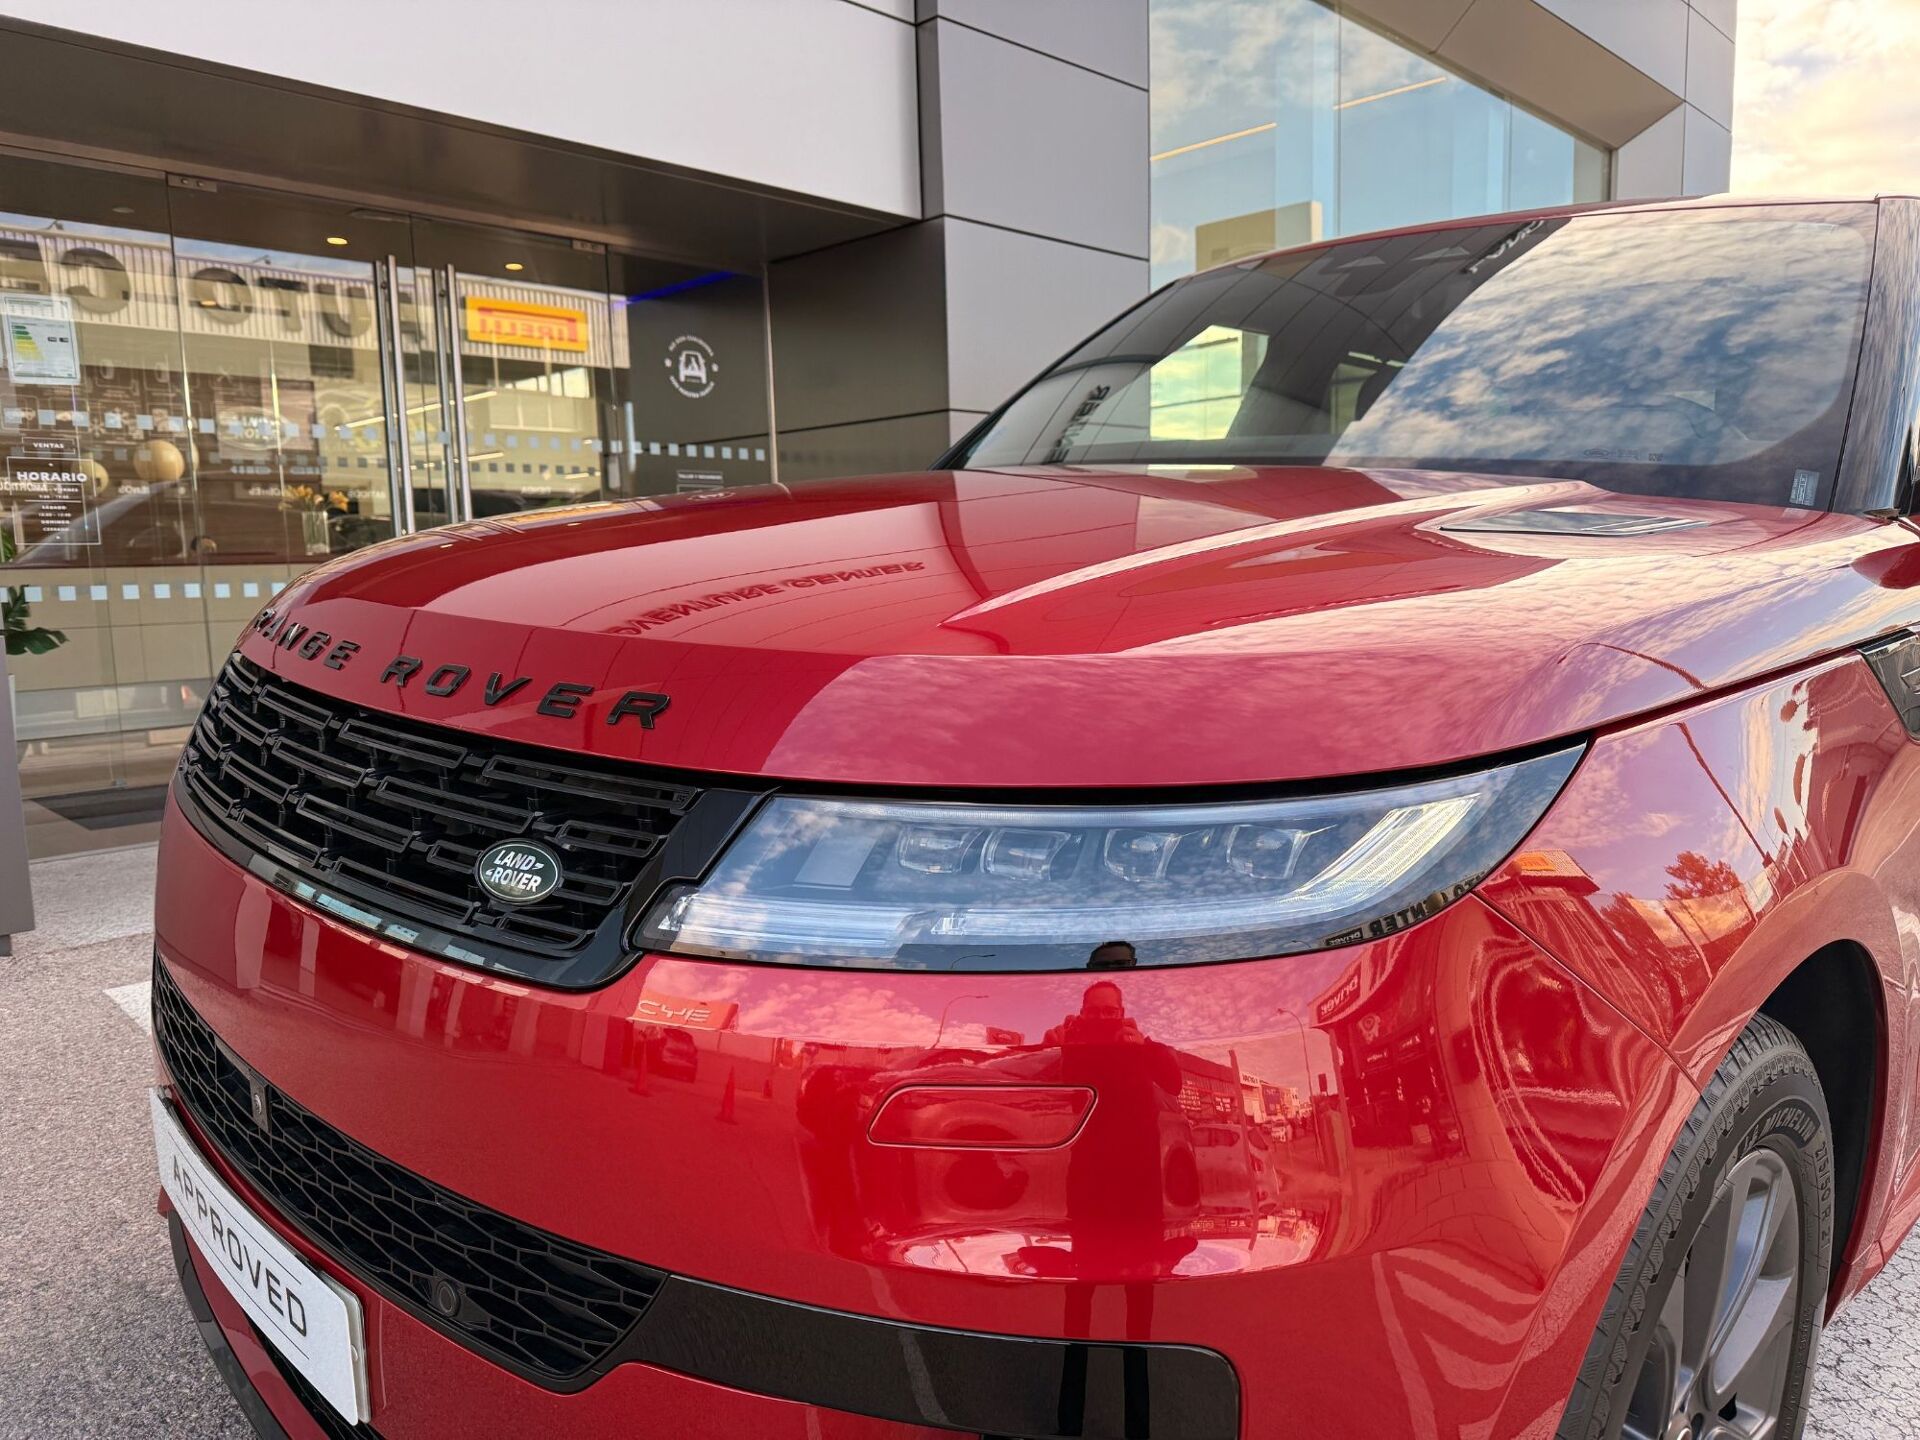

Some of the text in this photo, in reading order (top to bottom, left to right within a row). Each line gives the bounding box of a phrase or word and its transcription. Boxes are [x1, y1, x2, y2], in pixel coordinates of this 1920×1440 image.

[16, 471, 88, 482] HORARIO
[253, 608, 670, 730] RANGE ROVER
[493, 849, 537, 871] LAND
[490, 866, 542, 892] ROVER
[1759, 1107, 1815, 1142] MICHELIN
[172, 1154, 307, 1337] APPROVED
